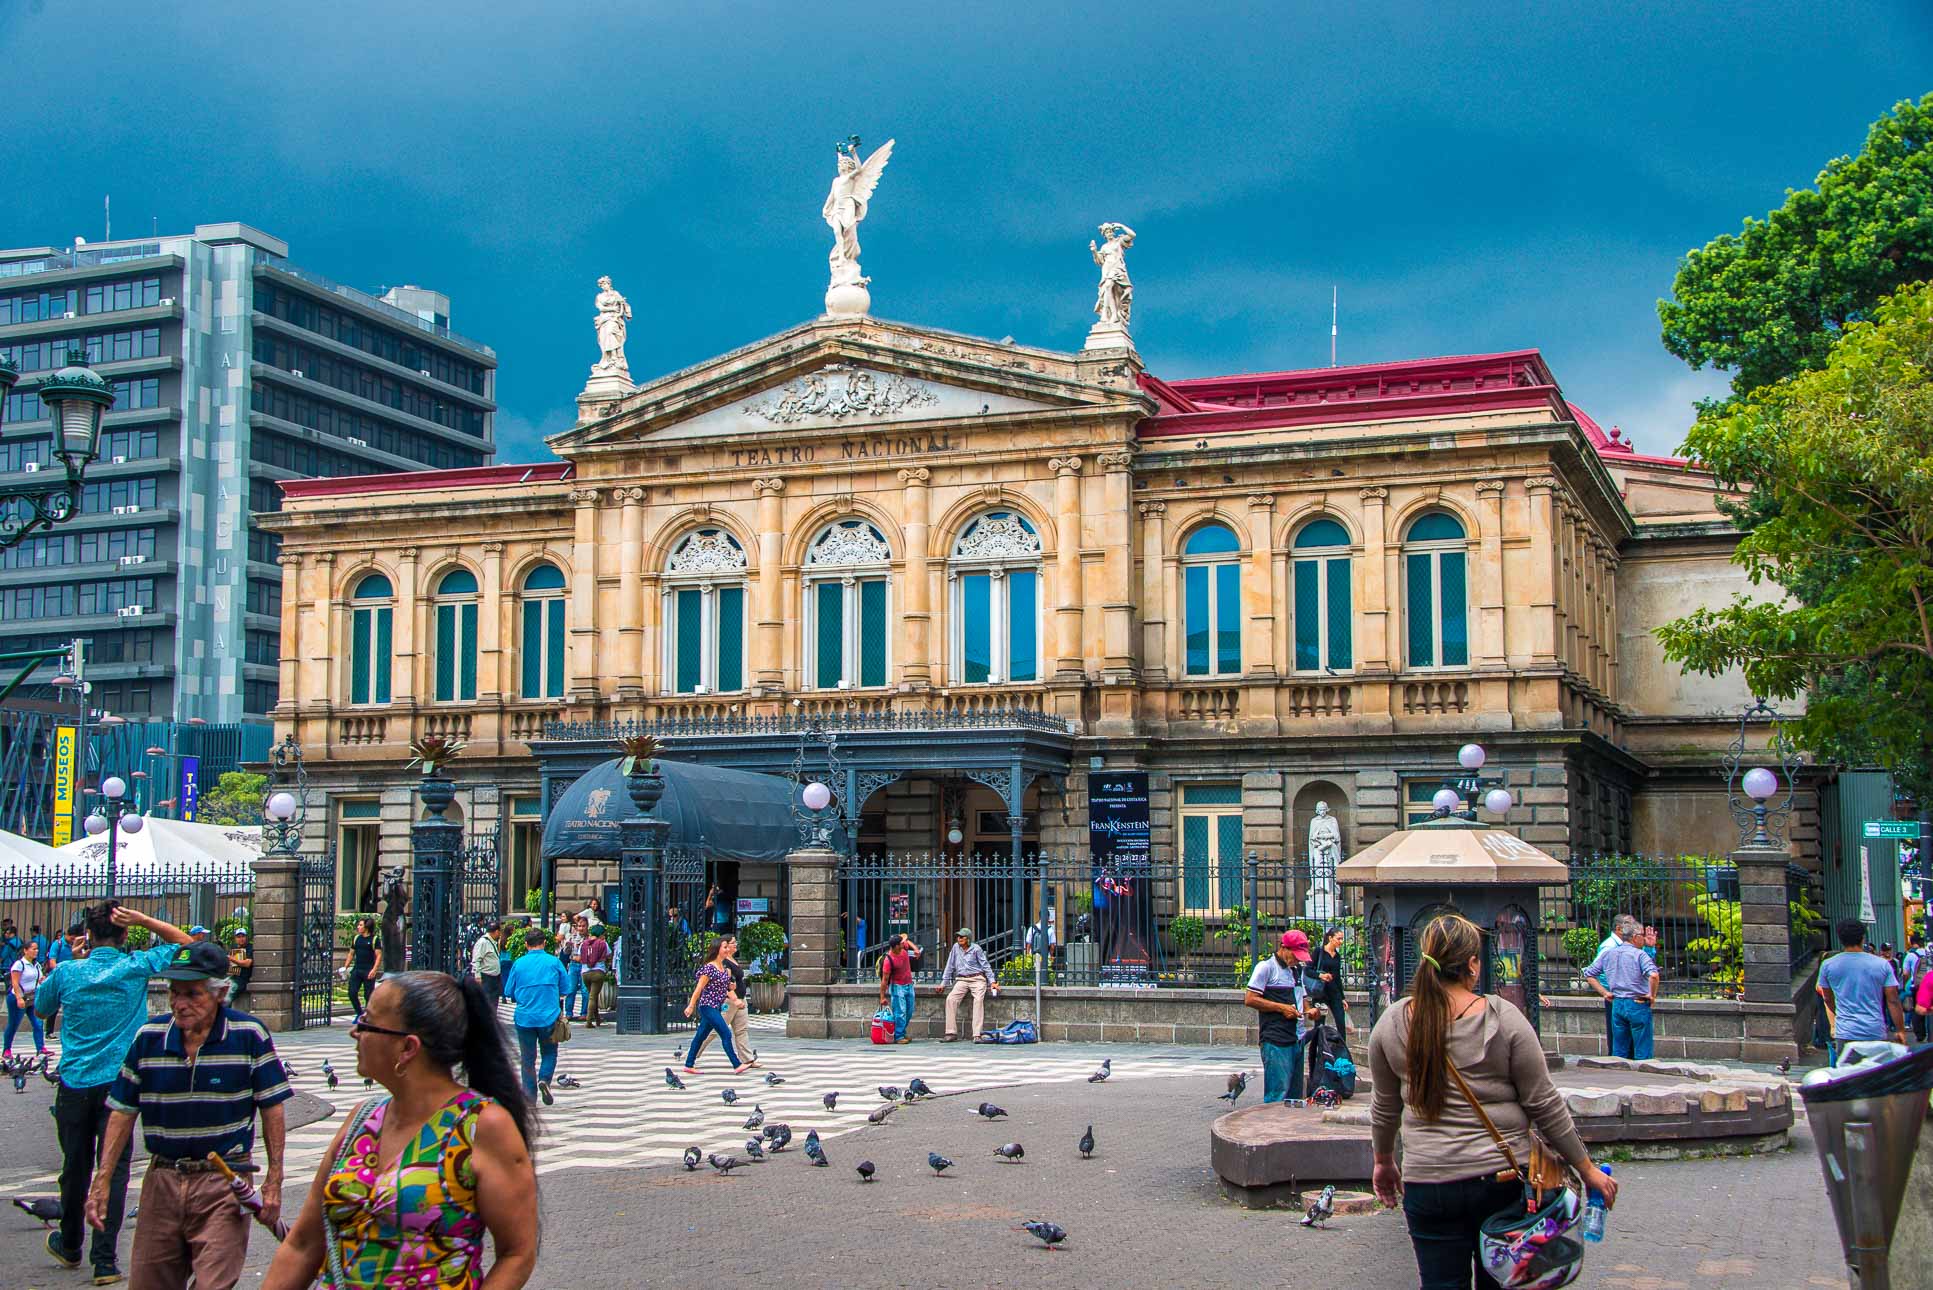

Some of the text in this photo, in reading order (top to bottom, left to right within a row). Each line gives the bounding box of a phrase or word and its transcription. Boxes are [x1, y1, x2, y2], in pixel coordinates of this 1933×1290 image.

[731, 430, 951, 466] TEATRO NACIONAL
[57, 735, 69, 801] MUSEOS
